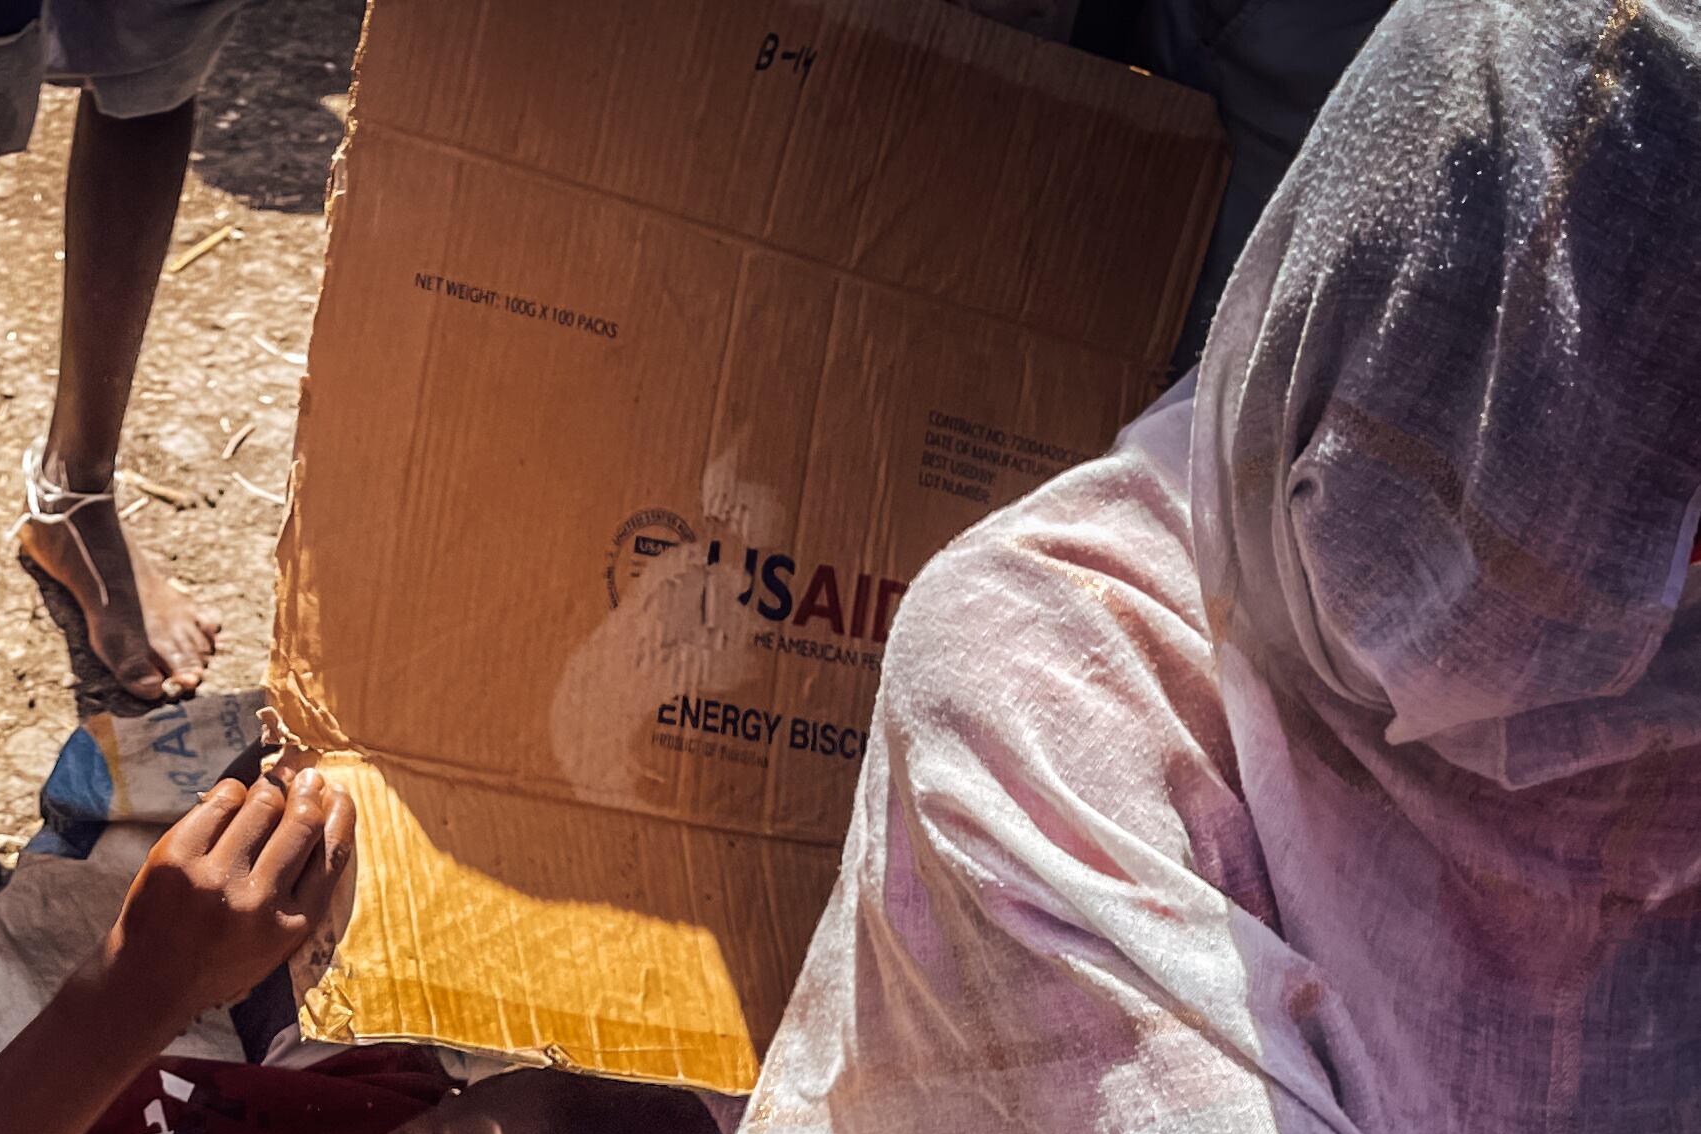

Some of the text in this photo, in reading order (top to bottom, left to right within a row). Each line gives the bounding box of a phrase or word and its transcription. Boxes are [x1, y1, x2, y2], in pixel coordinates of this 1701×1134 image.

[414, 272, 620, 340] NET WEIGHT: 100G X 100 PACKS
[928, 410, 986, 440] CONTRACT
[925, 431, 952, 453] DATE
[955, 440, 971, 456] OF
[918, 471, 941, 490] LOT
[753, 632, 777, 655] HE
[776, 637, 856, 668] AMERICAN
[657, 694, 781, 745] ENERGY
